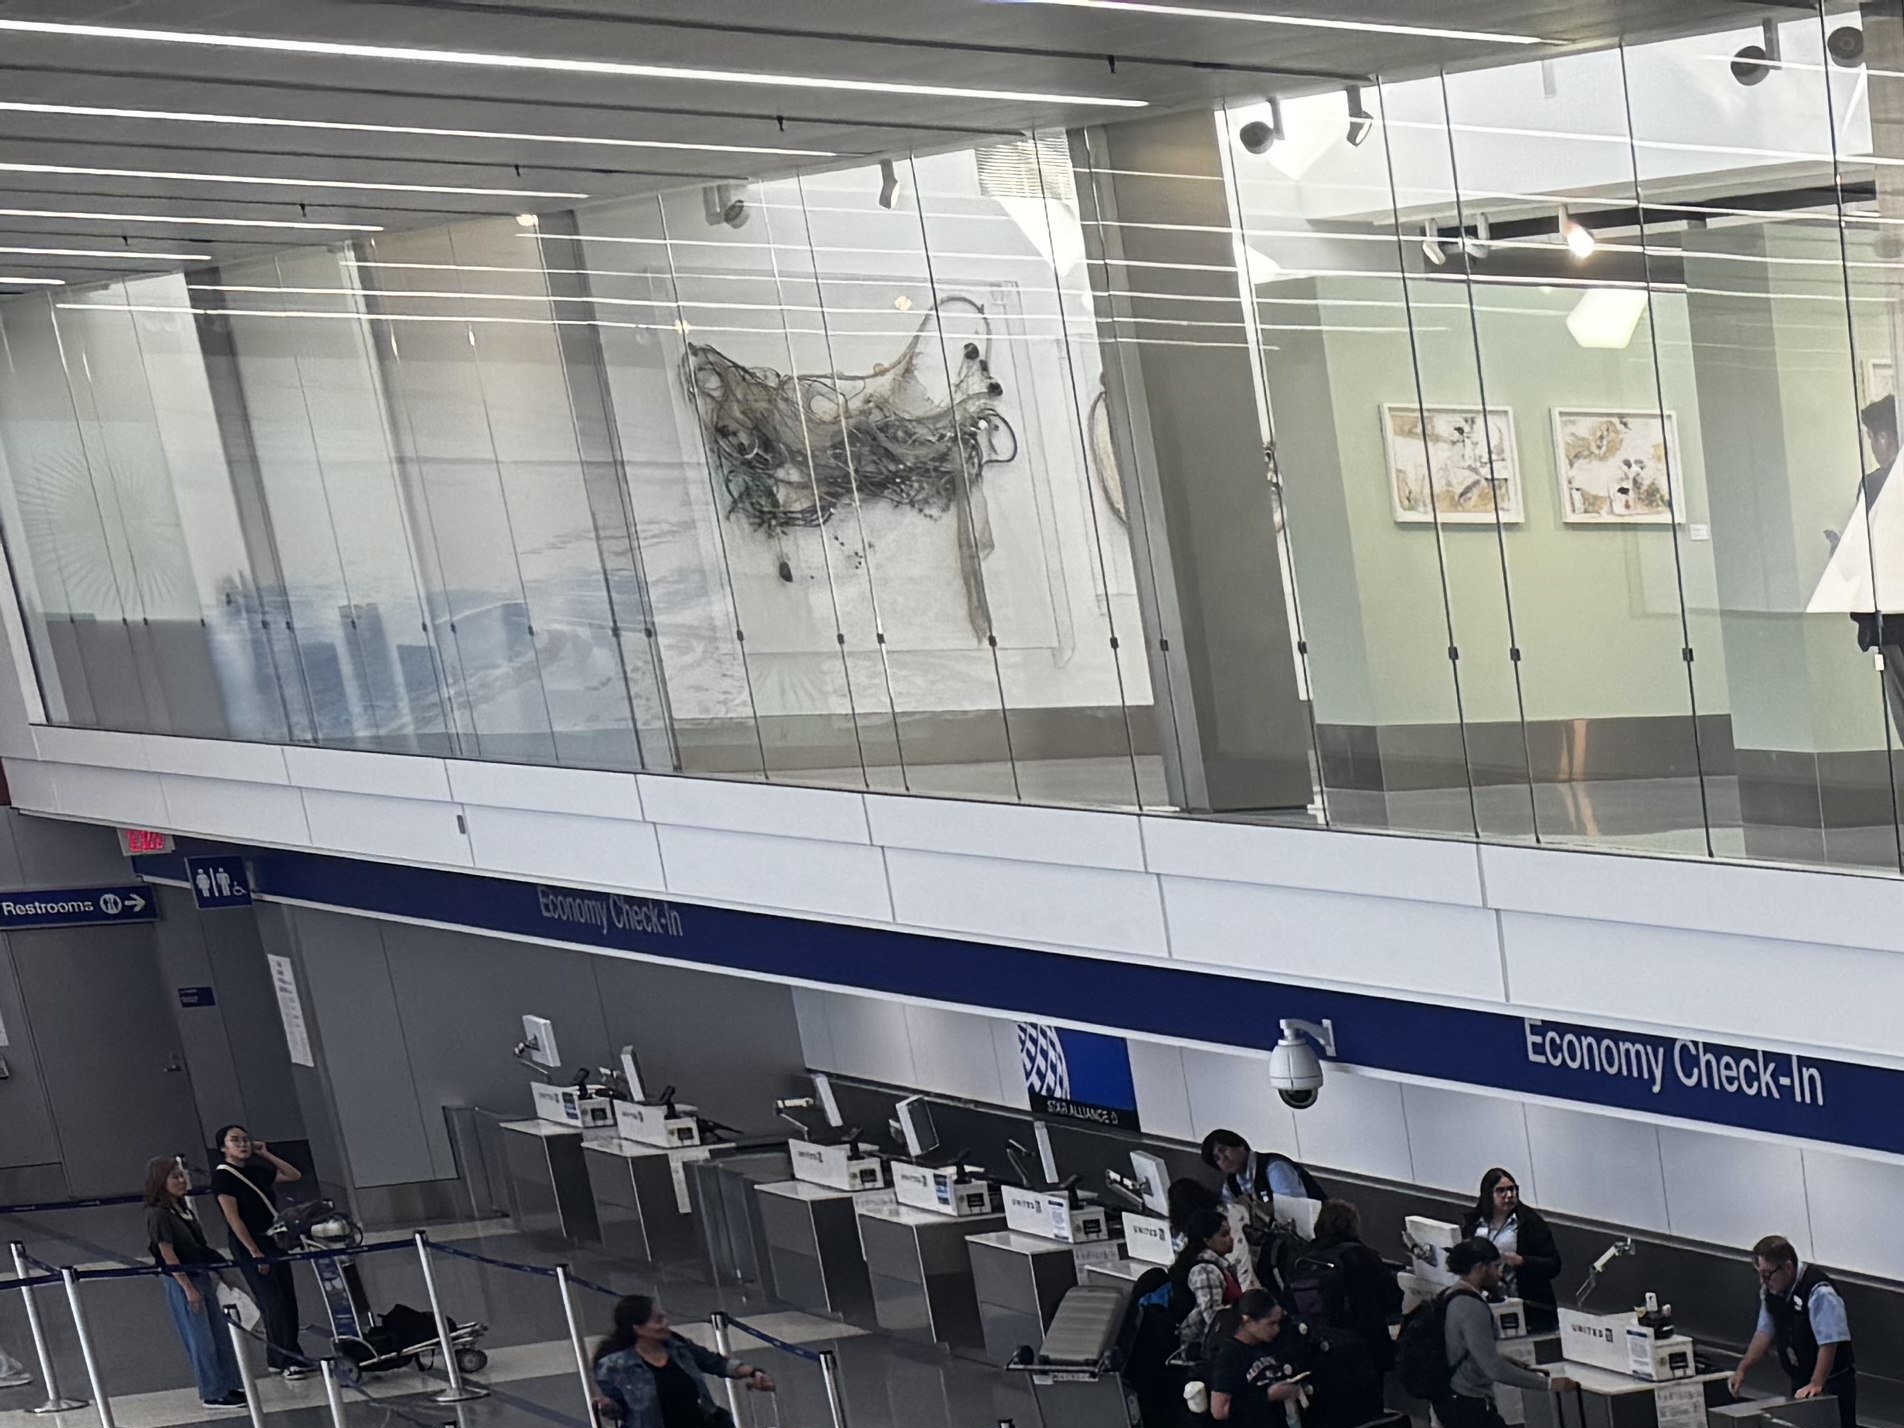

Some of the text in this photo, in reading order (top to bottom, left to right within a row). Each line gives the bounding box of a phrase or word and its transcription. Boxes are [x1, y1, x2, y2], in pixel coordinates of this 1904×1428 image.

[2, 899, 95, 917] Restrooms
[537, 885, 684, 937] Economy Check-In
[1524, 1017, 1824, 1106] Economy Check-In
